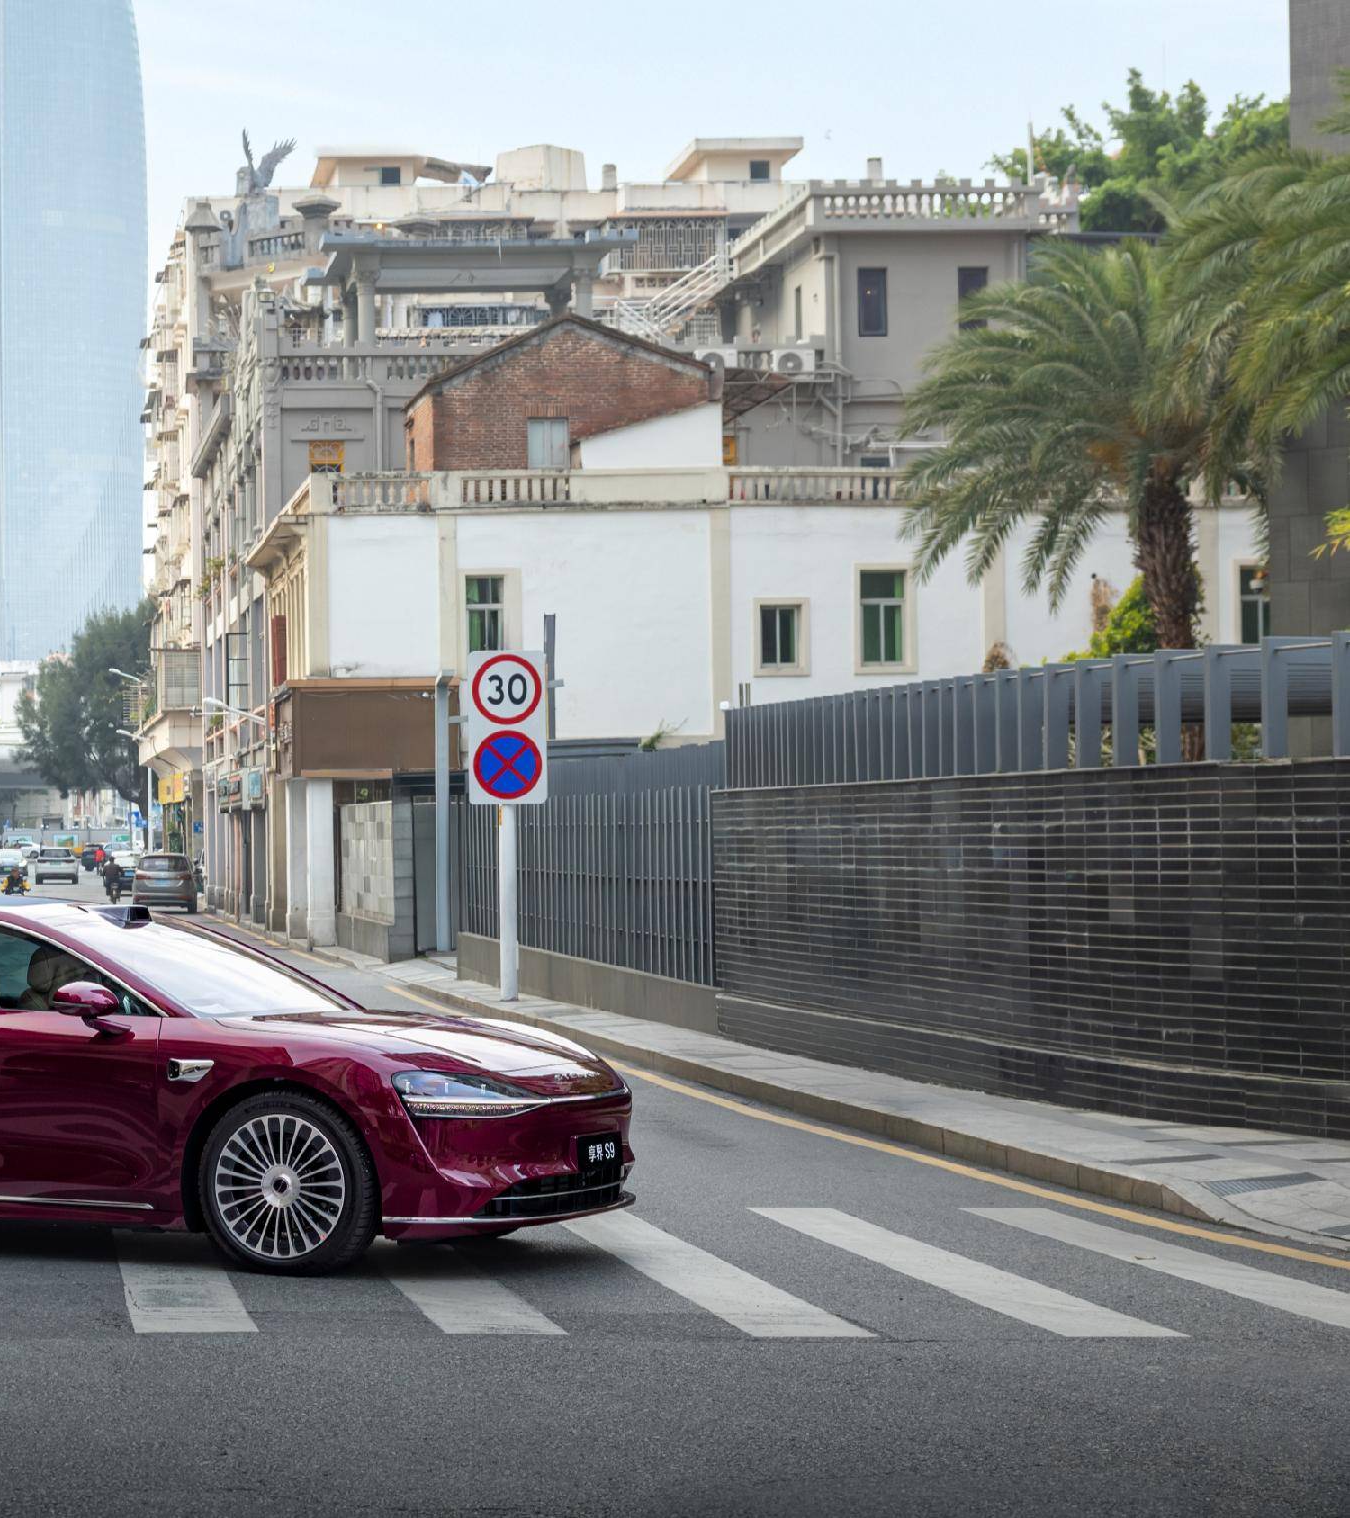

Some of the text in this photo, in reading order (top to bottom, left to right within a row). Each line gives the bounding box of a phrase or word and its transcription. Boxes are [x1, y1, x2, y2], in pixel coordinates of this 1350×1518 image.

[487, 673, 528, 705] 30
[588, 1142, 615, 1163] 享界 S9
